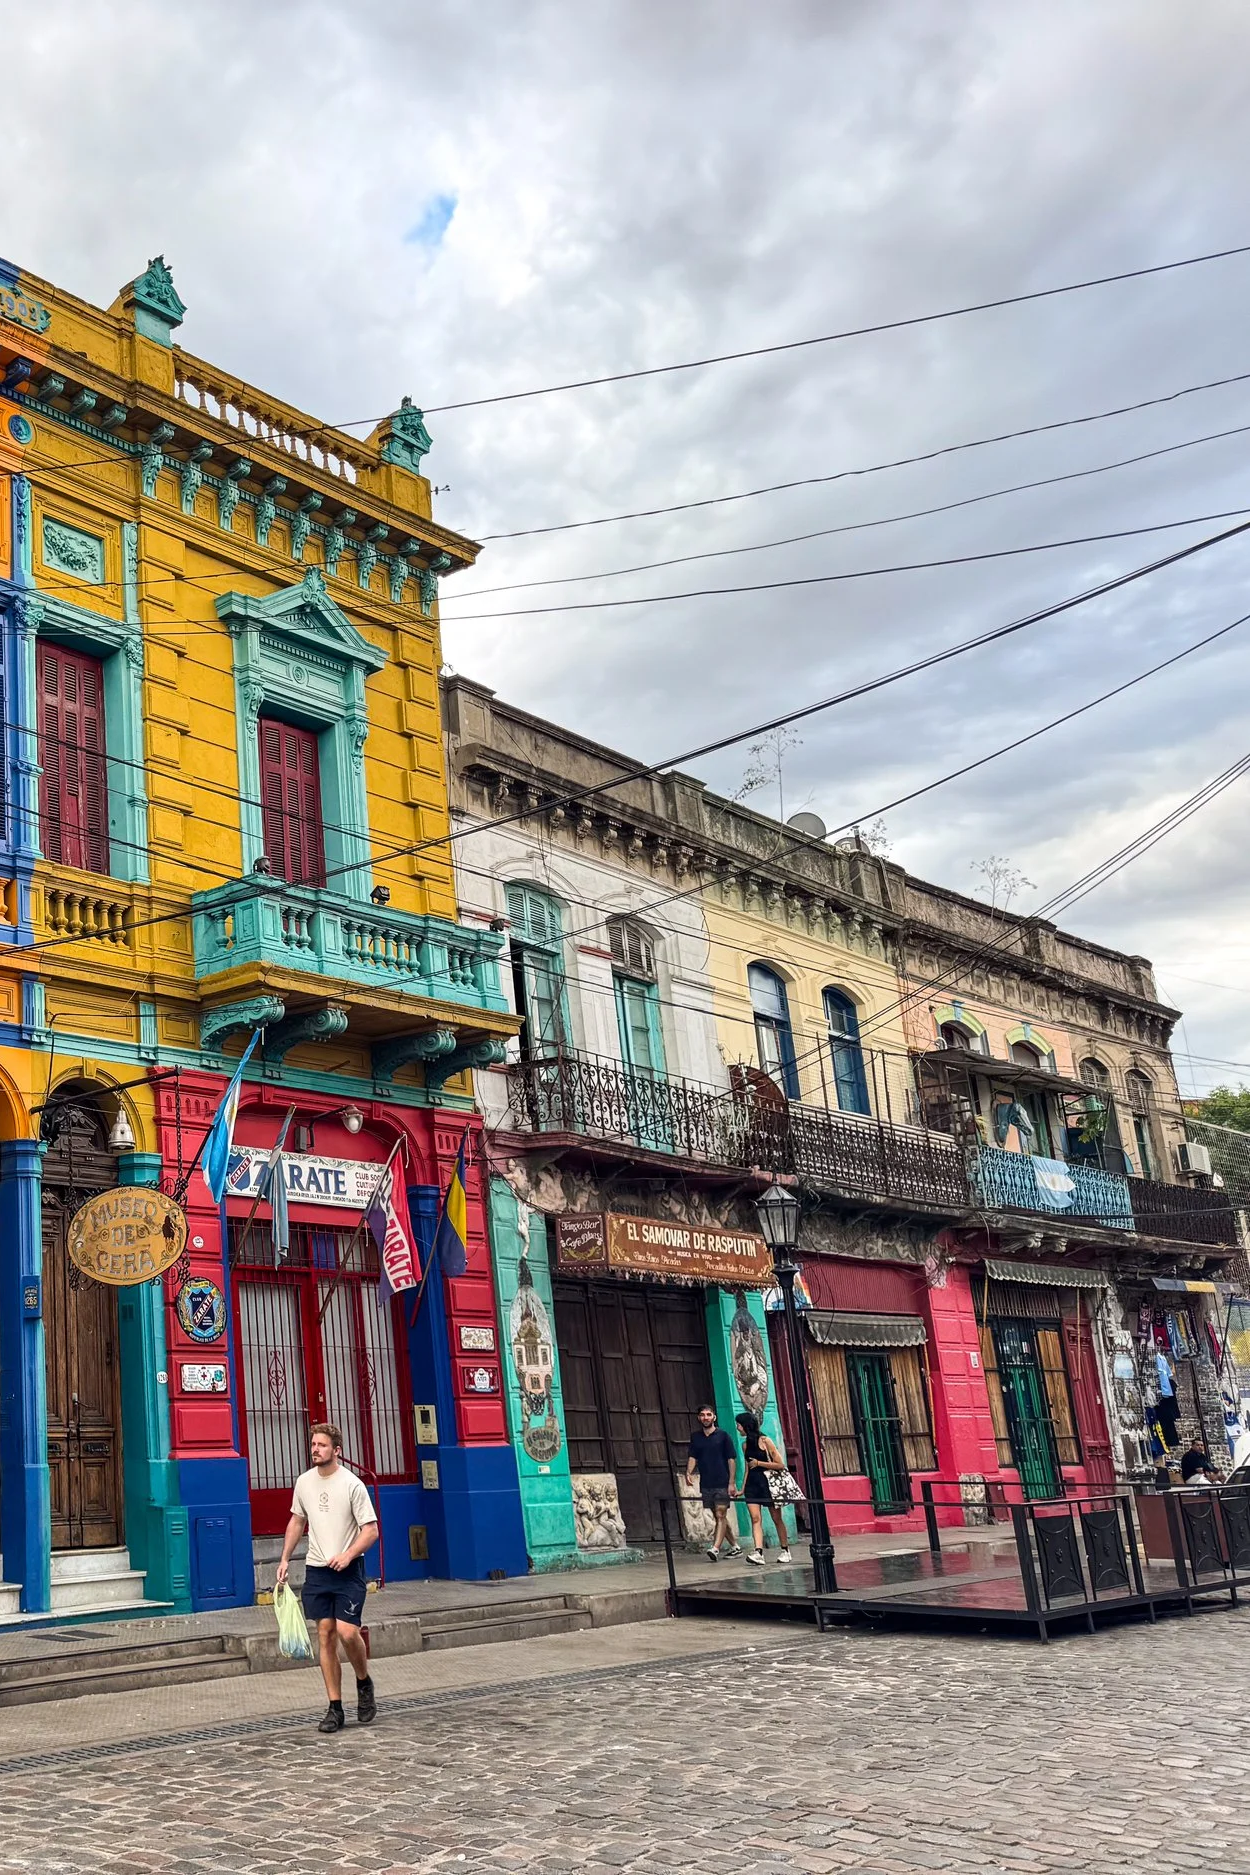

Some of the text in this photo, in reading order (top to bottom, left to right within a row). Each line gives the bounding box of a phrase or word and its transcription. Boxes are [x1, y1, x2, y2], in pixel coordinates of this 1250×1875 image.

[252, 1160, 347, 1196] ZRATE
[355, 1172, 369, 1180] CLUB
[91, 1197, 156, 1231] MUSEO
[583, 1220, 600, 1230] Bar
[111, 1224, 135, 1246] DE
[627, 1222, 757, 1257] EL SAMOVAR DE RASPUTIN
[96, 1250, 155, 1275] CERA
[194, 1295, 213, 1323] ZARATE
